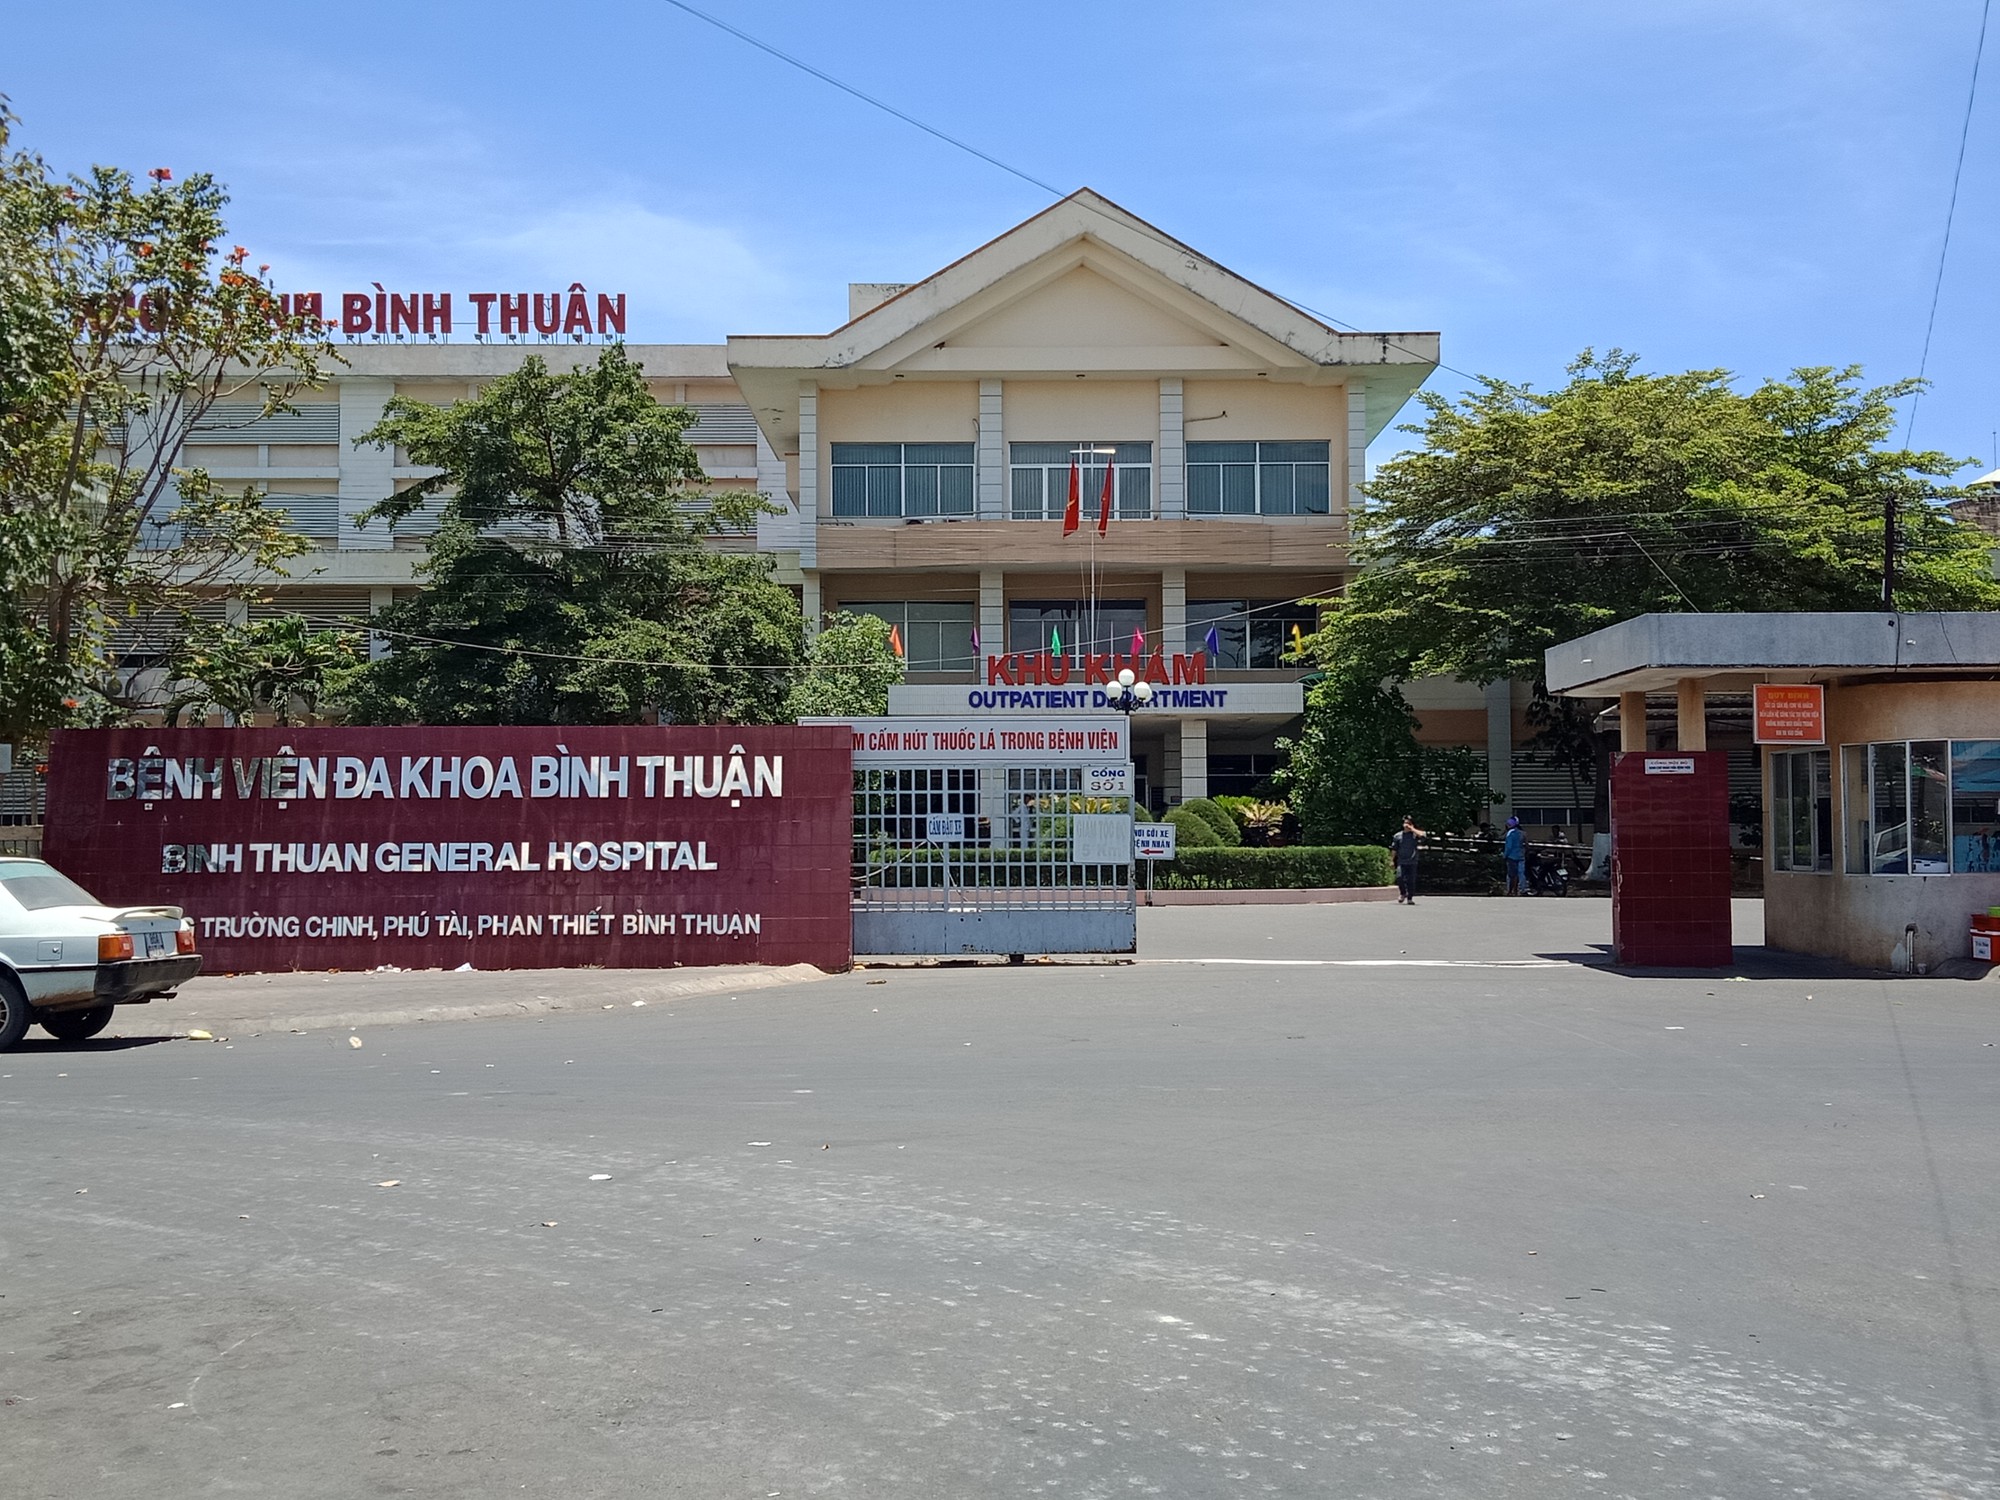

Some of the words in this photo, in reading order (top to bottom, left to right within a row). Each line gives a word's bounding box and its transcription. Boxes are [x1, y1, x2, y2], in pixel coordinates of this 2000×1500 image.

[343, 282, 451, 334] BÌNH
[987, 653, 1070, 686] KHU
[1085, 645, 1207, 686] KHÁM
[968, 690, 1088, 709] OUTPATIENT
[869, 727, 899, 751] CẤM
[903, 728, 928, 751] HÚT
[932, 726, 976, 750] THUỐC
[980, 728, 996, 750] LÁ
[1000, 731, 1045, 750] TRONG
[1048, 728, 1084, 754] BỆNH
[1087, 728, 1118, 753] VIỆN
[107, 745, 224, 810] BỆNH
[231, 745, 328, 810] VIỆN
[333, 756, 395, 799] ĐA
[400, 756, 523, 799] KHOA
[530, 744, 629, 798] BÌNH
[636, 744, 783, 808] THUẬN
[1118, 781, 1125, 791] 1
[1160, 829, 1169, 838] XE
[161, 843, 243, 874] BINH
[249, 843, 368, 873] THUAN
[374, 842, 541, 873] GENERAL
[548, 841, 718, 872] HOSPITAL
[200, 911, 300, 938] TRƯỜNG
[304, 915, 378, 940] CHINH,
[383, 911, 430, 936] PHÚ
[435, 910, 473, 939] TÀI,
[477, 915, 543, 936] PHAN
[548, 906, 615, 936] THIẾT
[622, 909, 676, 935] BÌNH
